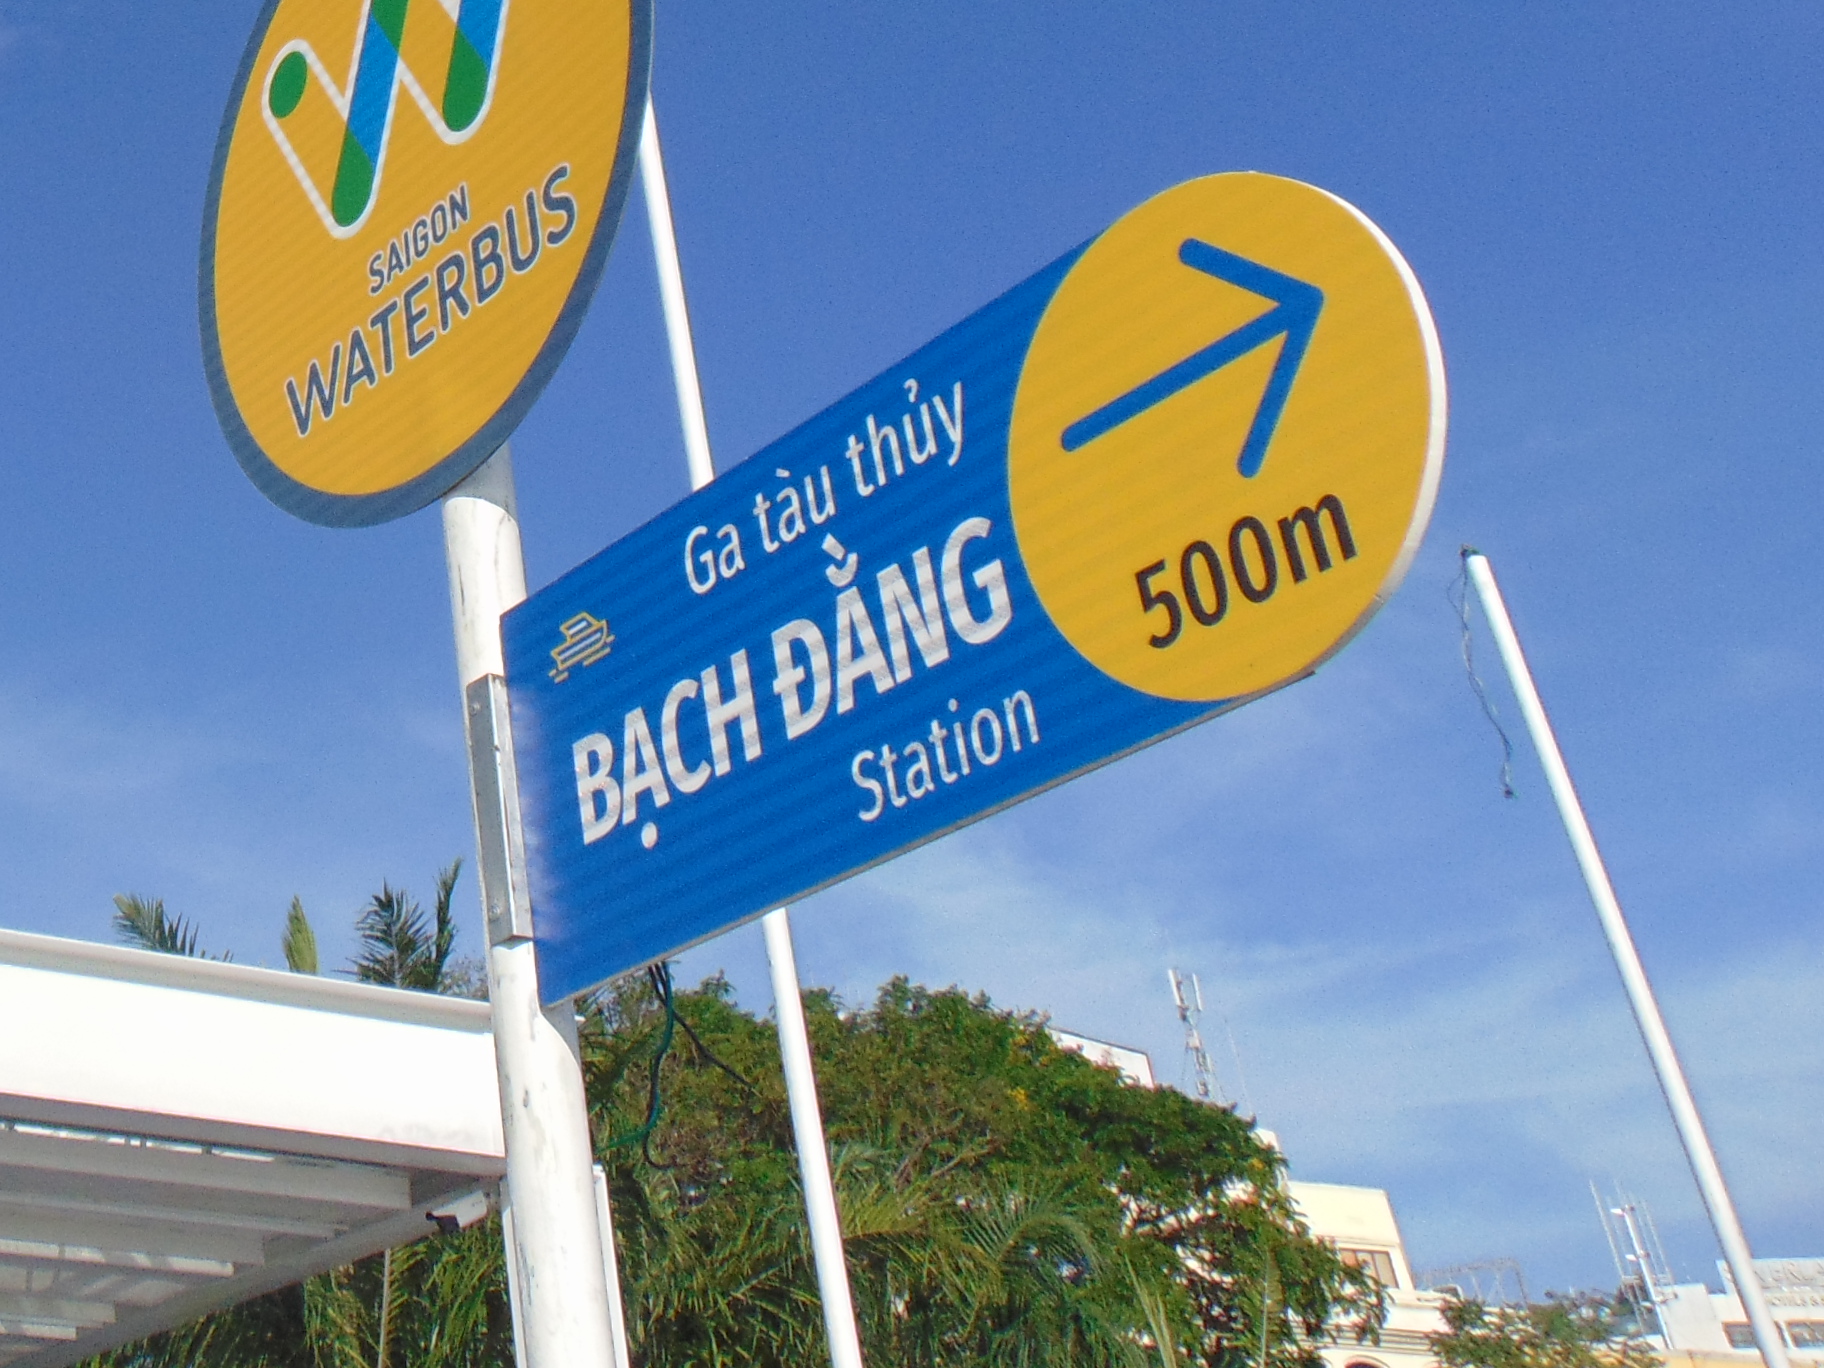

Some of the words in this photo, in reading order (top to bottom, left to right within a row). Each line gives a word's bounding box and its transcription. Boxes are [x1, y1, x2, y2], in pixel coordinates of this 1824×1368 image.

[284, 162, 578, 437] WATERBUS
[368, 182, 470, 296] SAIGON
[684, 524, 746, 596] Ga
[752, 465, 838, 554] tàu
[844, 377, 964, 498] thủy
[1134, 493, 1359, 651] 500m
[572, 648, 764, 850] BẠCH
[771, 516, 1015, 741] ĐẰNG
[850, 688, 1041, 824] Station
